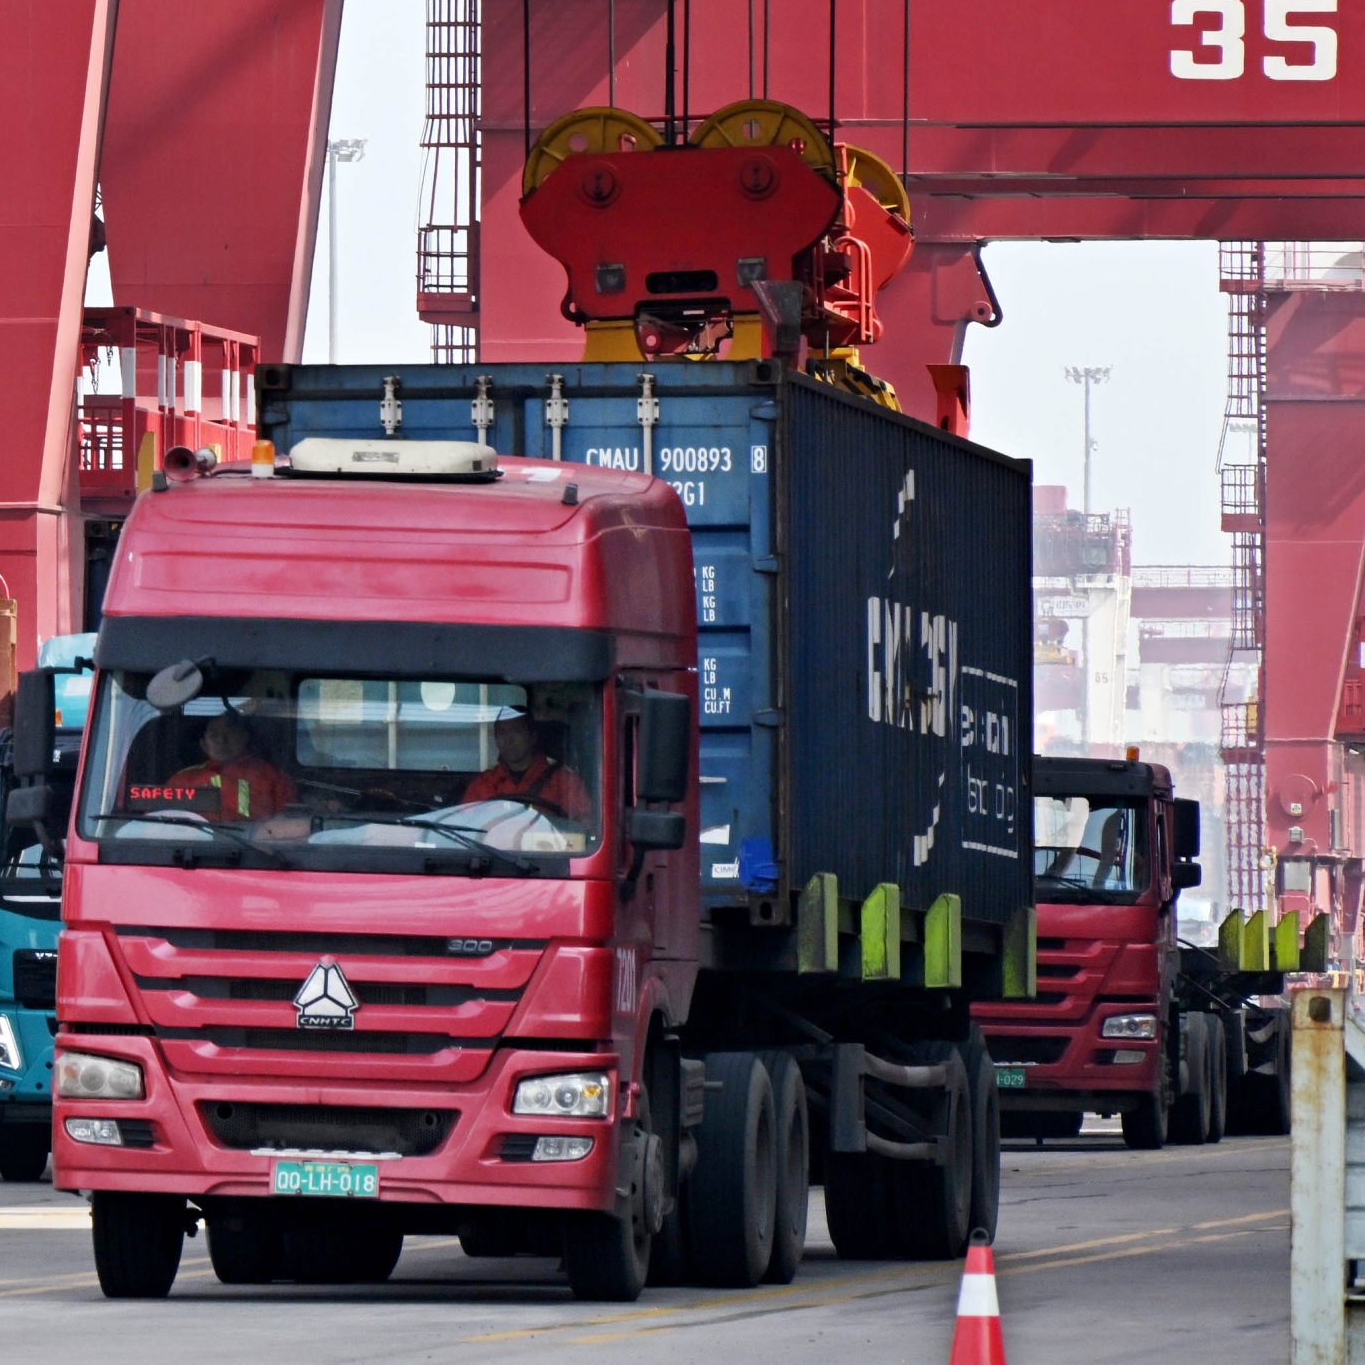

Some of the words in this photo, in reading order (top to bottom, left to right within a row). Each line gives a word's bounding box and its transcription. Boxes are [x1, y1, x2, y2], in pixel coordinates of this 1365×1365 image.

[585, 447, 639, 471] CMAU
[660, 447, 732, 472] 900893
[752, 446, 765, 472] 8
[702, 566, 715, 579] KG
[702, 579, 715, 592] LB
[703, 596, 716, 609] KG
[703, 609, 716, 622] LB
[704, 658, 717, 671] KG
[704, 672, 716, 684] LB
[130, 786, 197, 801] SAFETY
[448, 939, 492, 952] 300
[616, 947, 636, 1013] 7201
[299, 1017, 351, 1026] CNHTC
